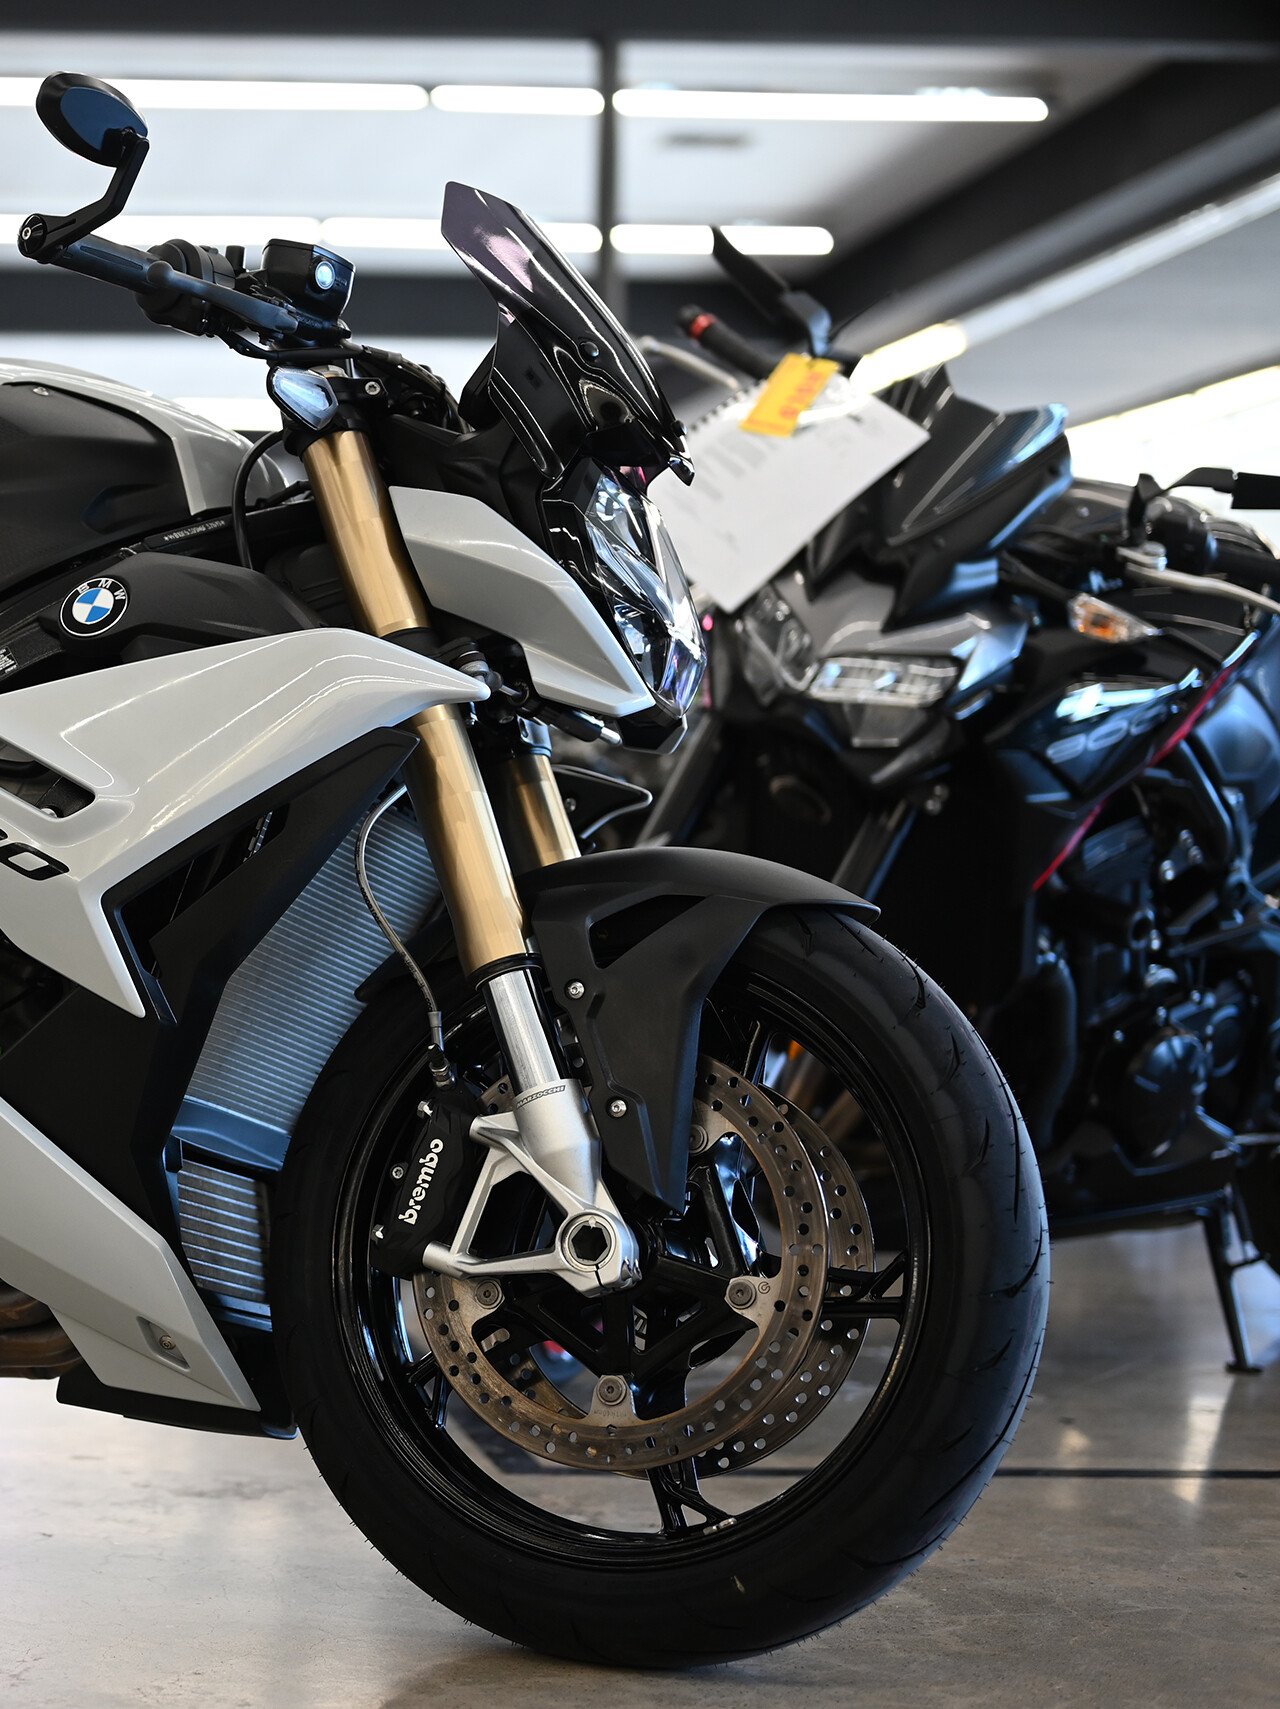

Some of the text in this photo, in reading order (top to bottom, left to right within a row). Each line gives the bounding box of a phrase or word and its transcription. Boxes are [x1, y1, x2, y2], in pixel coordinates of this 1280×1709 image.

[76, 579, 126, 600] BMW
[517, 1085, 566, 1109] MARZOCCHI
[398, 1138, 444, 1225] brembo
